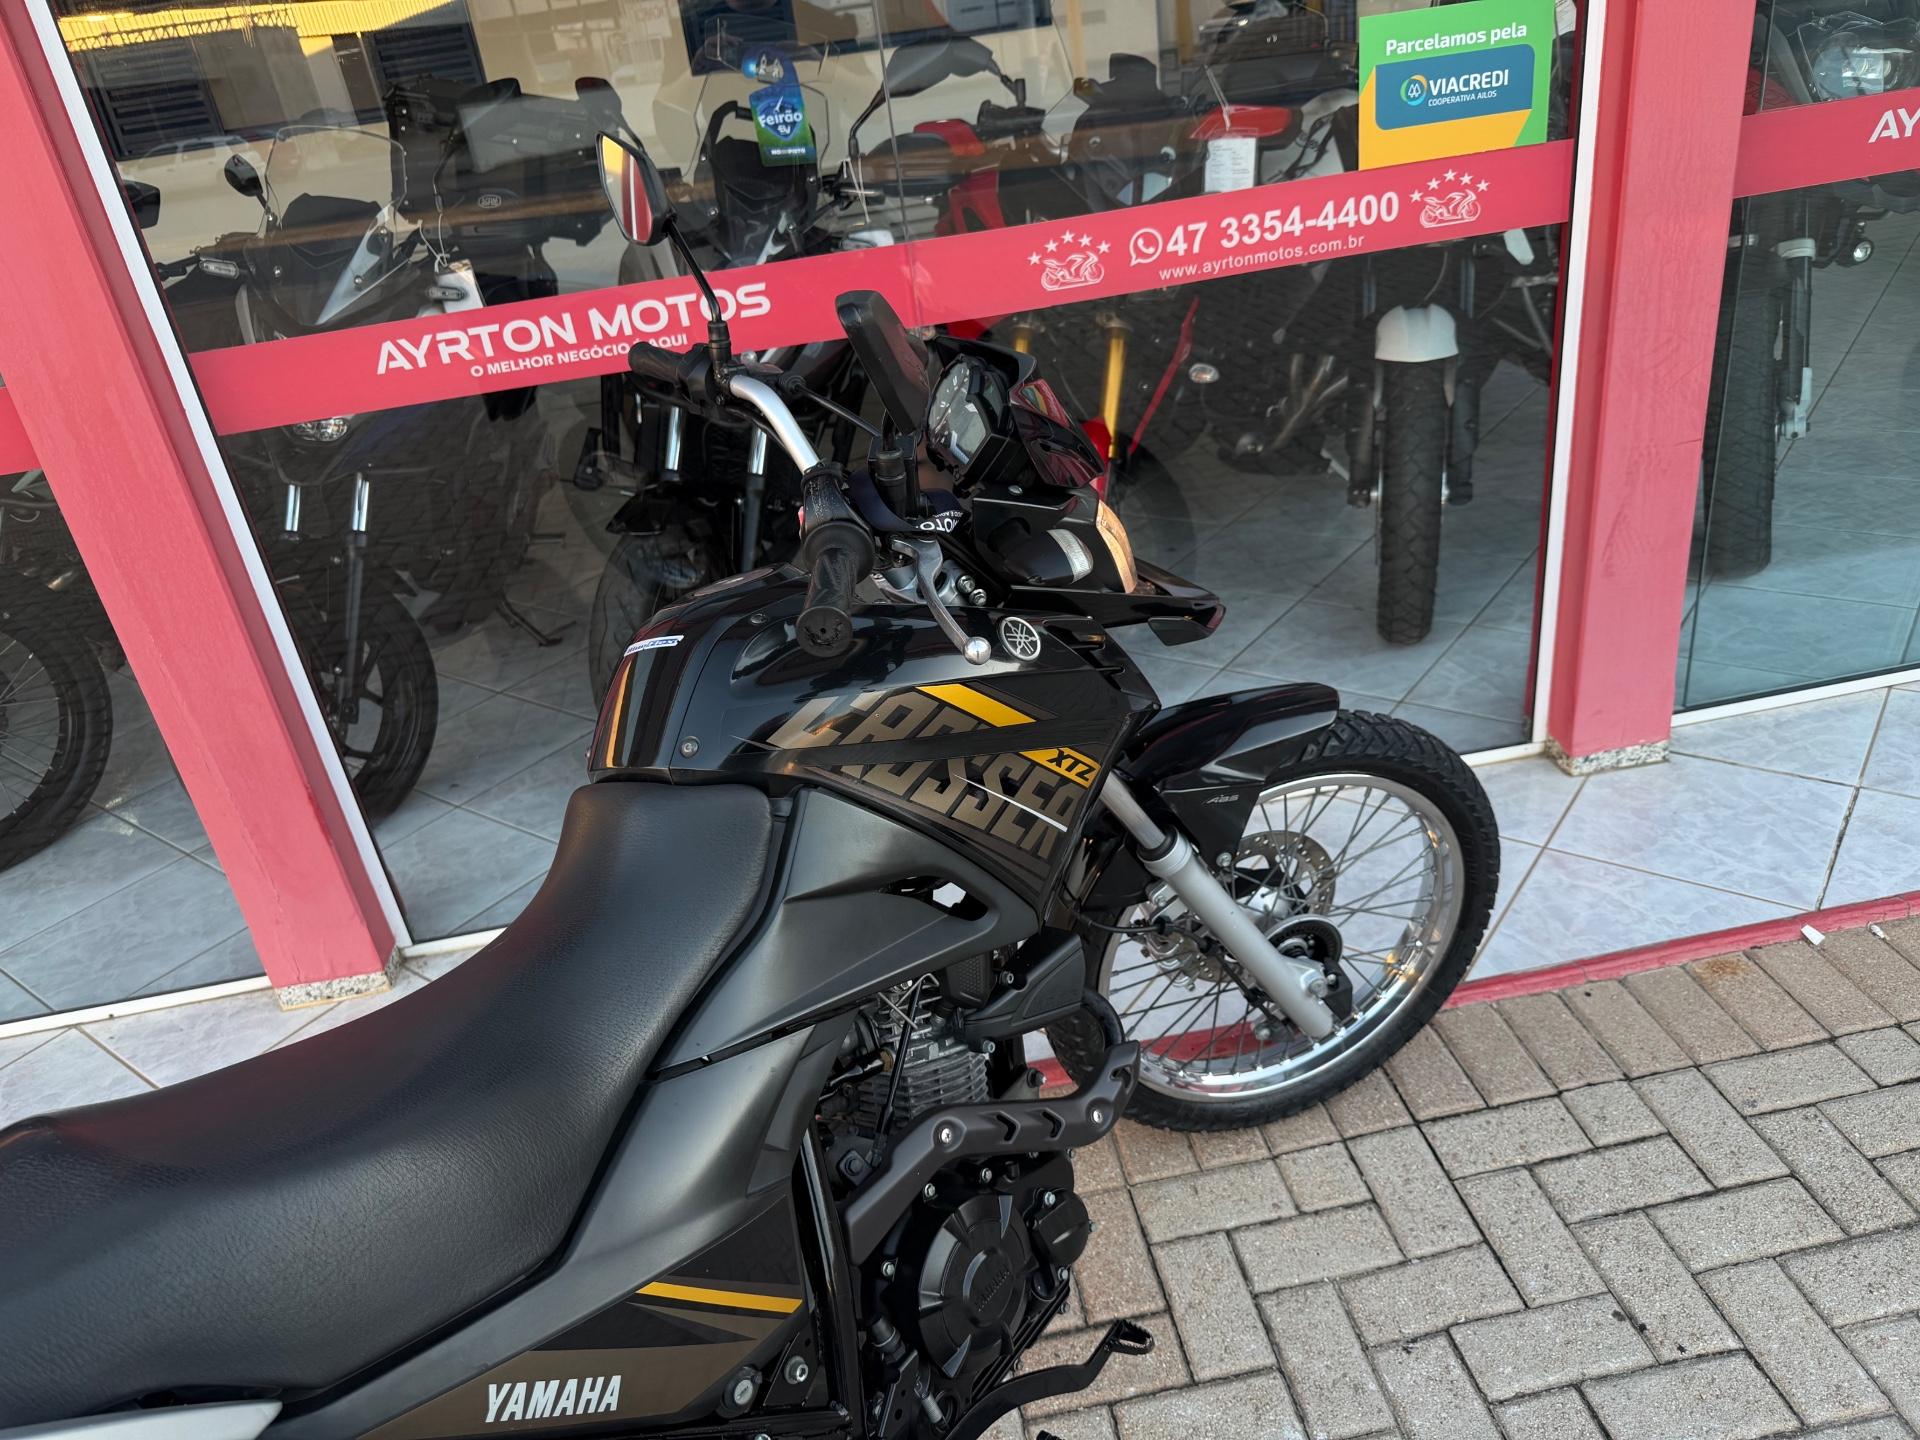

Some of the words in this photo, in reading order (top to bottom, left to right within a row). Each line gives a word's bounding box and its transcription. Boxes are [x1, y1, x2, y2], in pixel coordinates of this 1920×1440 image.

[1386, 30, 1487, 56] Parcelamos
[1490, 22, 1527, 45] pela
[1428, 93, 1476, 107] COOPERATIVA
[1477, 90, 1497, 99] AILOS
[1429, 69, 1509, 96] VIACREDI
[758, 109, 803, 128] Feirão
[1868, 107, 1920, 144] AY
[1167, 222, 1208, 256] 47
[1220, 191, 1399, 249] 3354-4400
[1159, 234, 1365, 281] www.ayrtonmotos.com.br
[376, 312, 577, 375] AYRTON
[588, 282, 771, 340] MOTOS
[470, 365, 484, 377] O
[487, 354, 554, 375] MELHOR
[557, 342, 630, 365] NEGÓCIO
[649, 334, 688, 349] AQUI
[1045, 748, 1097, 783] XTZ
[485, 1375, 622, 1423] YAMAHA
